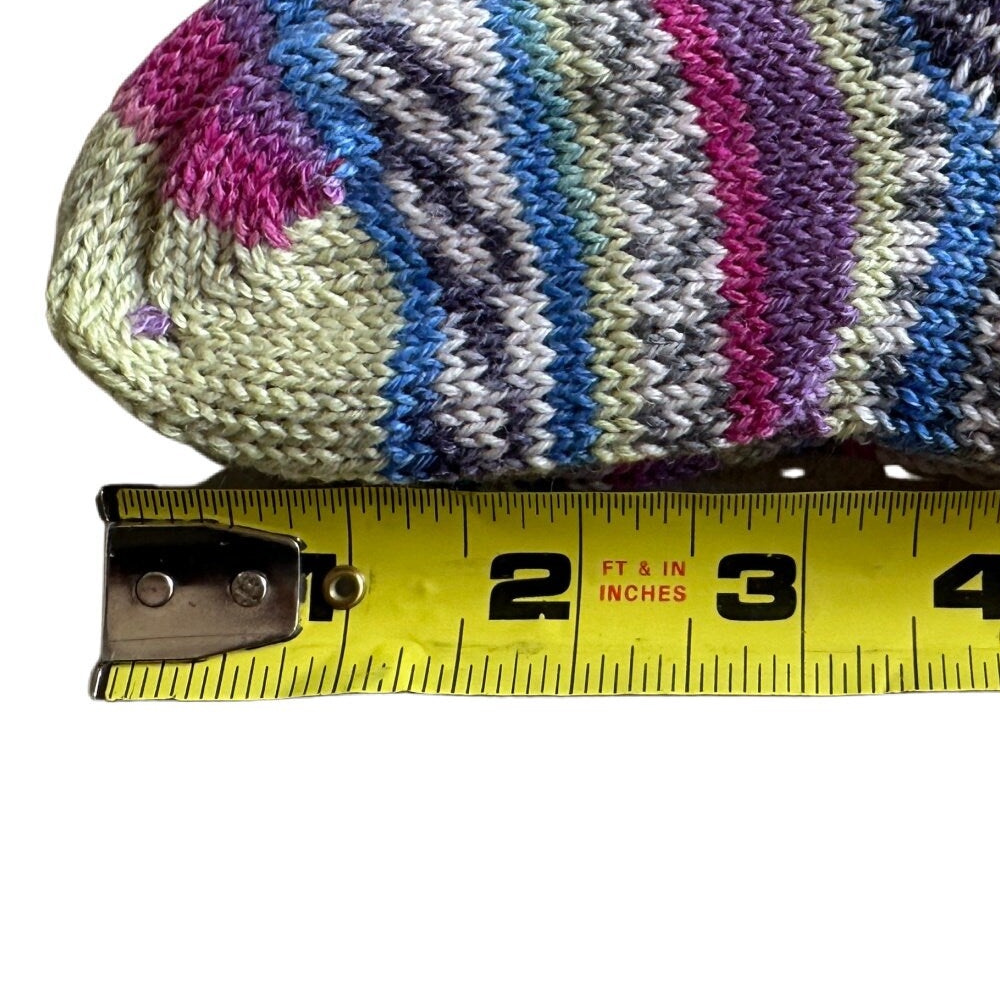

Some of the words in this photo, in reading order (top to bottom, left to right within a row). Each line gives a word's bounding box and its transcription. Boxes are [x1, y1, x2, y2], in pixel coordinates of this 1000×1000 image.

[602, 560, 627, 576] FT
[639, 560, 651, 576] &
[663, 560, 686, 576] IN
[301, 552, 336, 622] 1
[489, 552, 572, 621] 2
[717, 552, 796, 622] 3
[599, 584, 687, 602] INCHES
